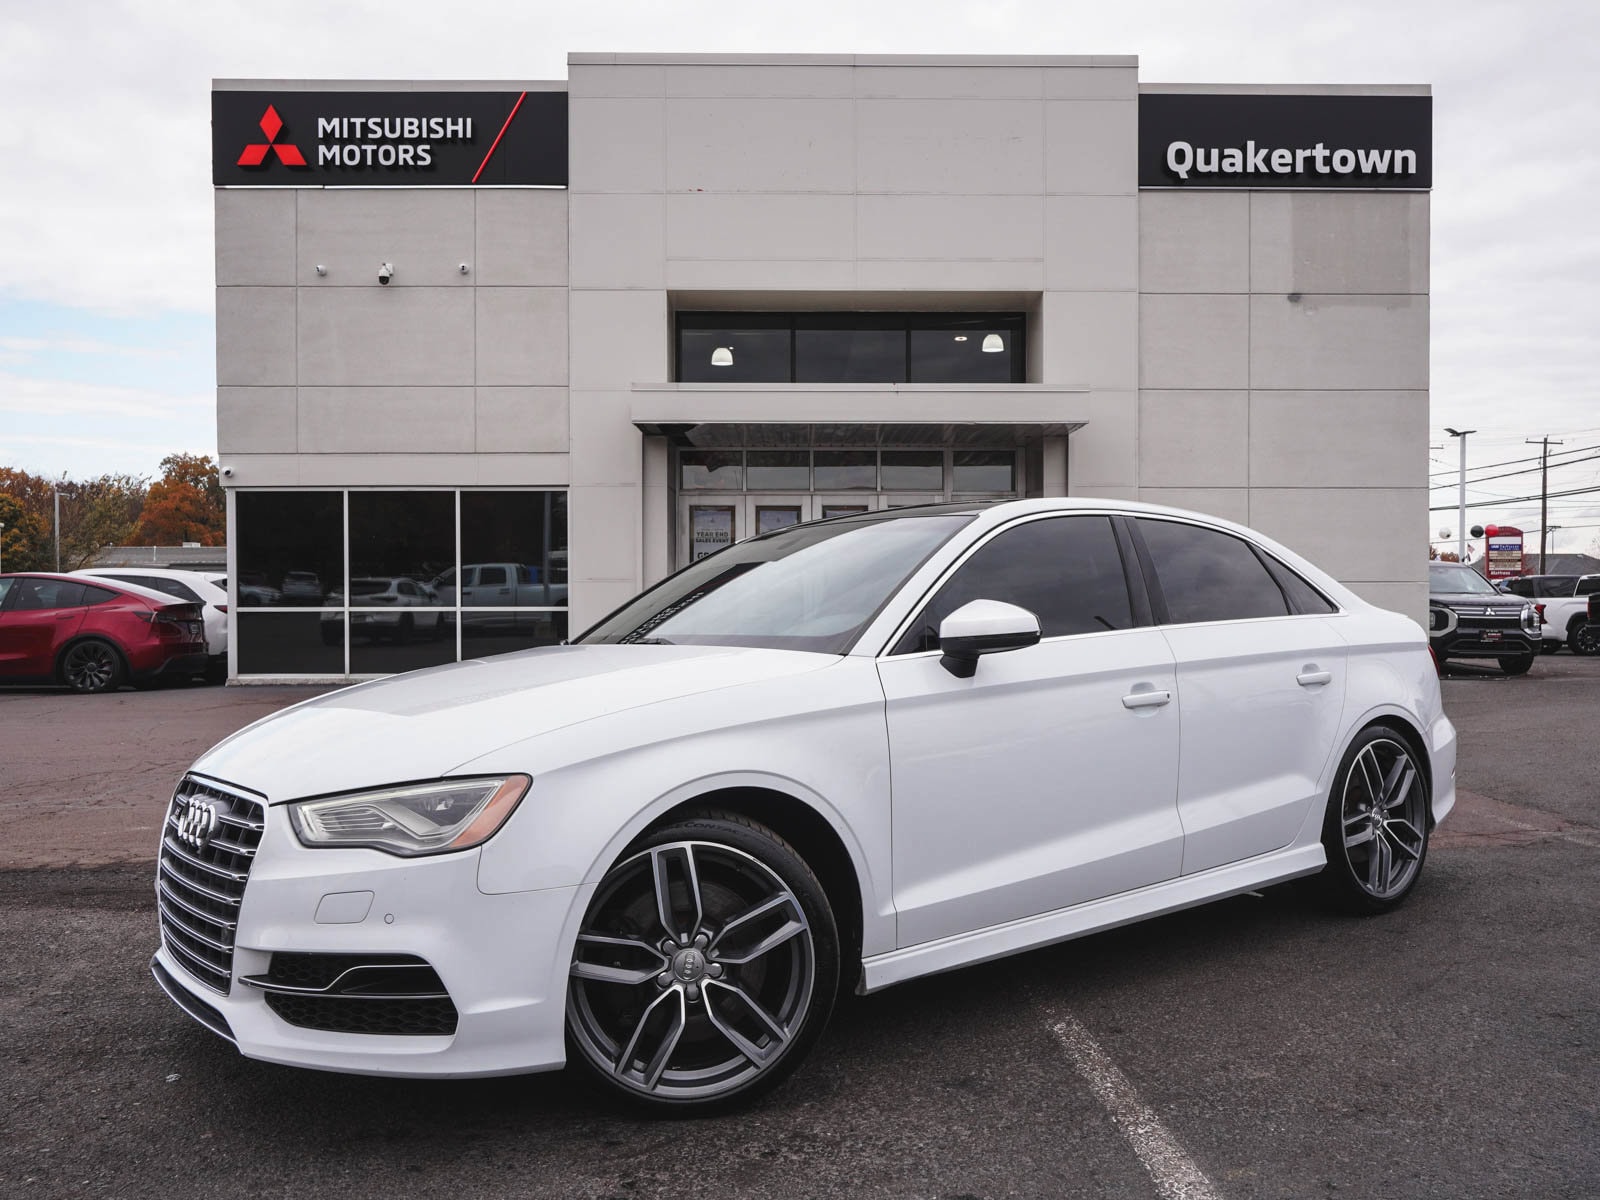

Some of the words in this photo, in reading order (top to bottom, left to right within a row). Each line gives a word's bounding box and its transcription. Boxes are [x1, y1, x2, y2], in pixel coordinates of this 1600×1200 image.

[317, 117, 472, 139] MITSUBISHI
[318, 144, 432, 166] MOTORS
[1166, 140, 1417, 179] Quakertown
